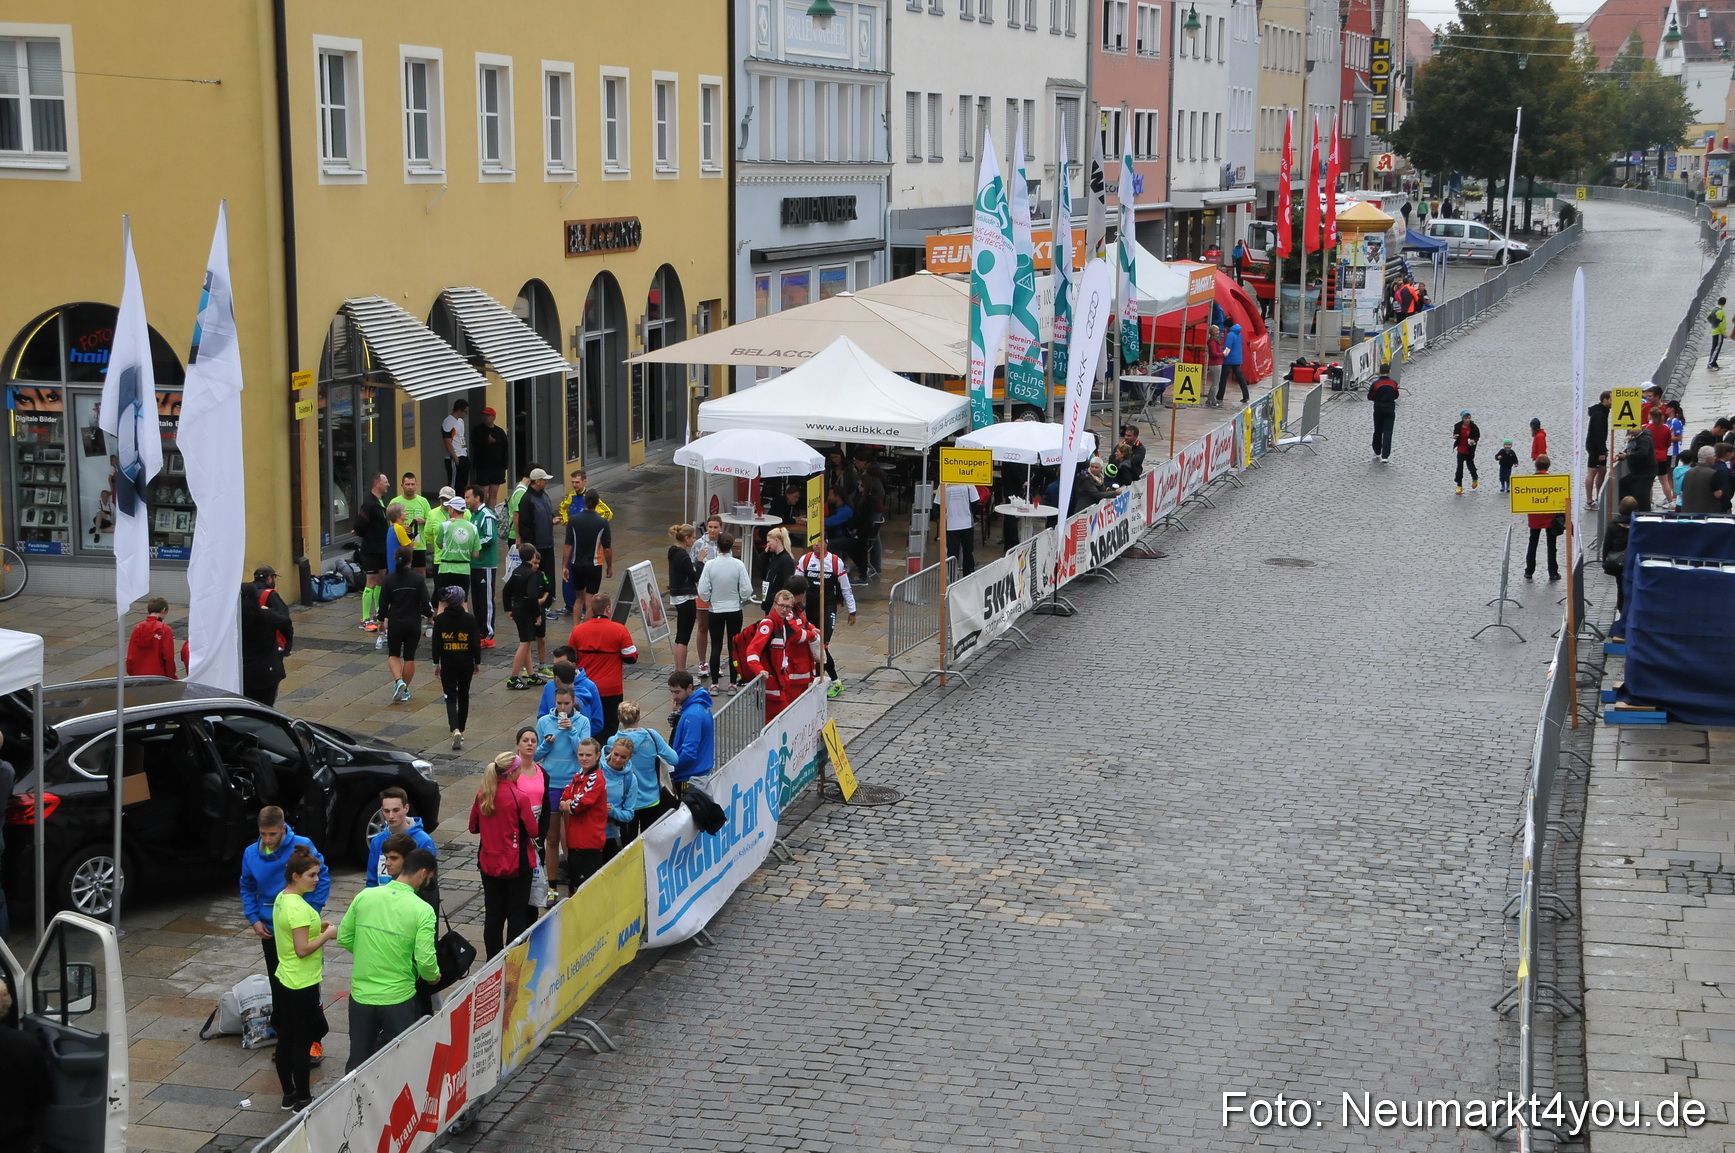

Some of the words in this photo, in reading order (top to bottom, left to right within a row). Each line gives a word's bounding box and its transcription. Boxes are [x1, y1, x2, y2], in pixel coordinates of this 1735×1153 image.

[788, 197, 824, 224] BRILLEN
[826, 195, 858, 222] WEBER
[1178, 364, 1199, 373] Block
[1179, 375, 1195, 395] A
[1615, 389, 1639, 398] Block
[1617, 400, 1635, 421] A
[15, 415, 38, 423] Digitale
[805, 422, 900, 436] www.audibkk.de
[943, 457, 989, 468] Schnupper-
[713, 465, 733, 473] Audi
[734, 467, 751, 475] BKK
[958, 468, 974, 476] lauf
[1514, 486, 1566, 496] Schnupper-
[1531, 496, 1549, 504] lauf
[983, 570, 1018, 621] SWM
[444, 1062, 468, 1102] Braun
[423, 1090, 439, 1116] Braun
[397, 1113, 417, 1150] Braun
